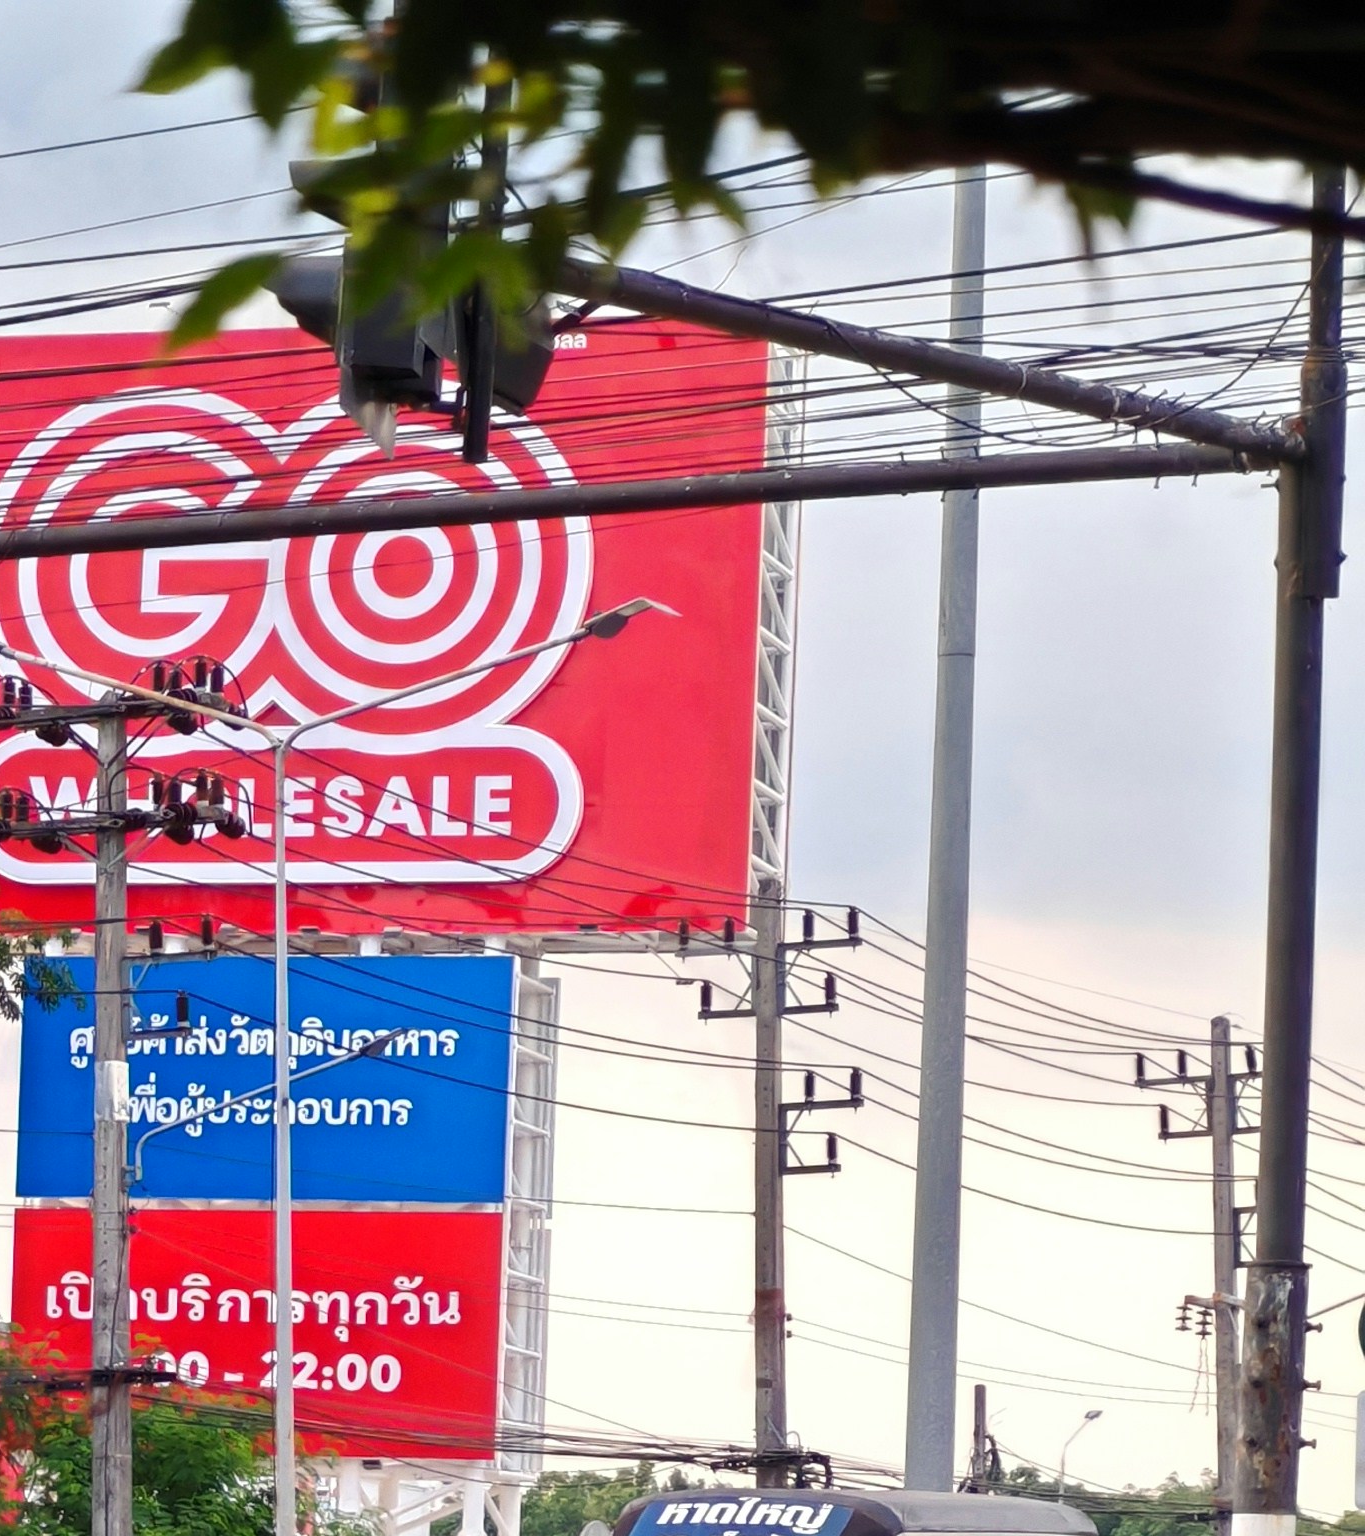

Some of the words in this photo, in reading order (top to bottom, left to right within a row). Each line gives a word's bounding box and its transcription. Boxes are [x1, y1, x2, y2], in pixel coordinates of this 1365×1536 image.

[70, 1014, 460, 1068] ศูย์ค้าส่งวัตุดิบอาหาร
[127, 1072, 413, 1137] พื่อผู้ประอบการ
[46, 1270, 462, 1342] เปิบริการทุกวัน
[260, 1351, 402, 1393] 22:00
[656, 1496, 834, 1534] หาดใหญ่
